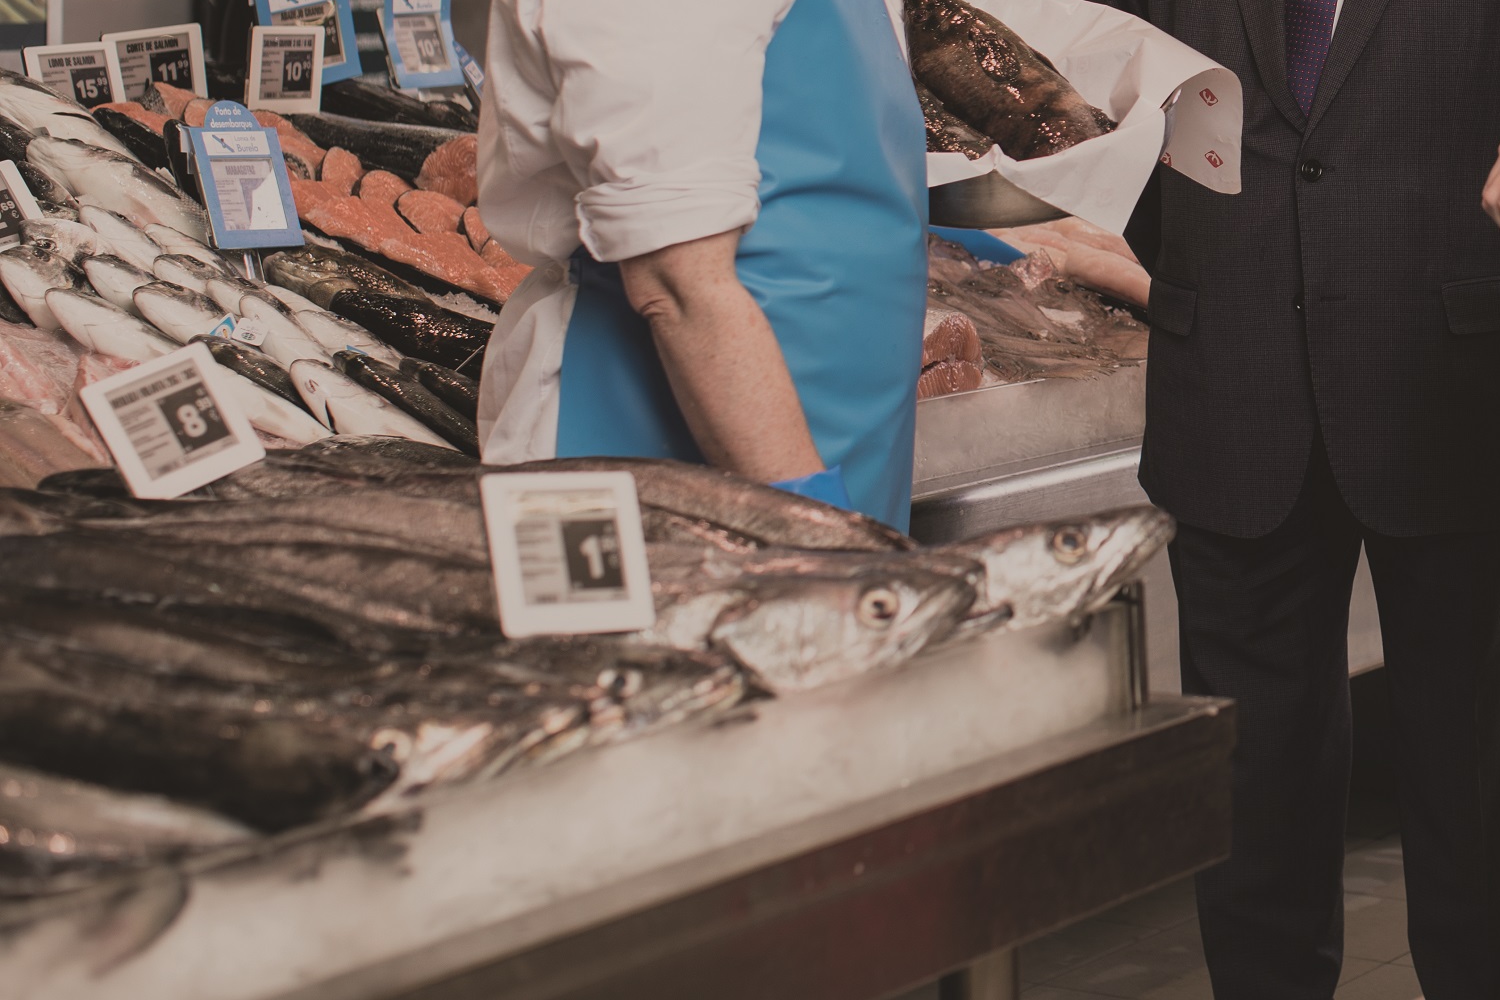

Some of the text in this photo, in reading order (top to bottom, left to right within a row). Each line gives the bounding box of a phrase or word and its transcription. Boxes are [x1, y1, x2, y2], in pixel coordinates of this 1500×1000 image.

[127, 38, 179, 54] CORTE DE SALMON
[417, 40, 435, 58] 10
[48, 55, 96, 68] LOMO DE SALMON
[158, 62, 178, 82] 11
[285, 61, 302, 82] 10
[75, 78, 98, 100] 15
[214, 106, 242, 116] Porto de
[210, 118, 253, 130] desembarque
[236, 144, 259, 152] Burela
[176, 403, 208, 438] 8
[579, 534, 605, 580] 1
